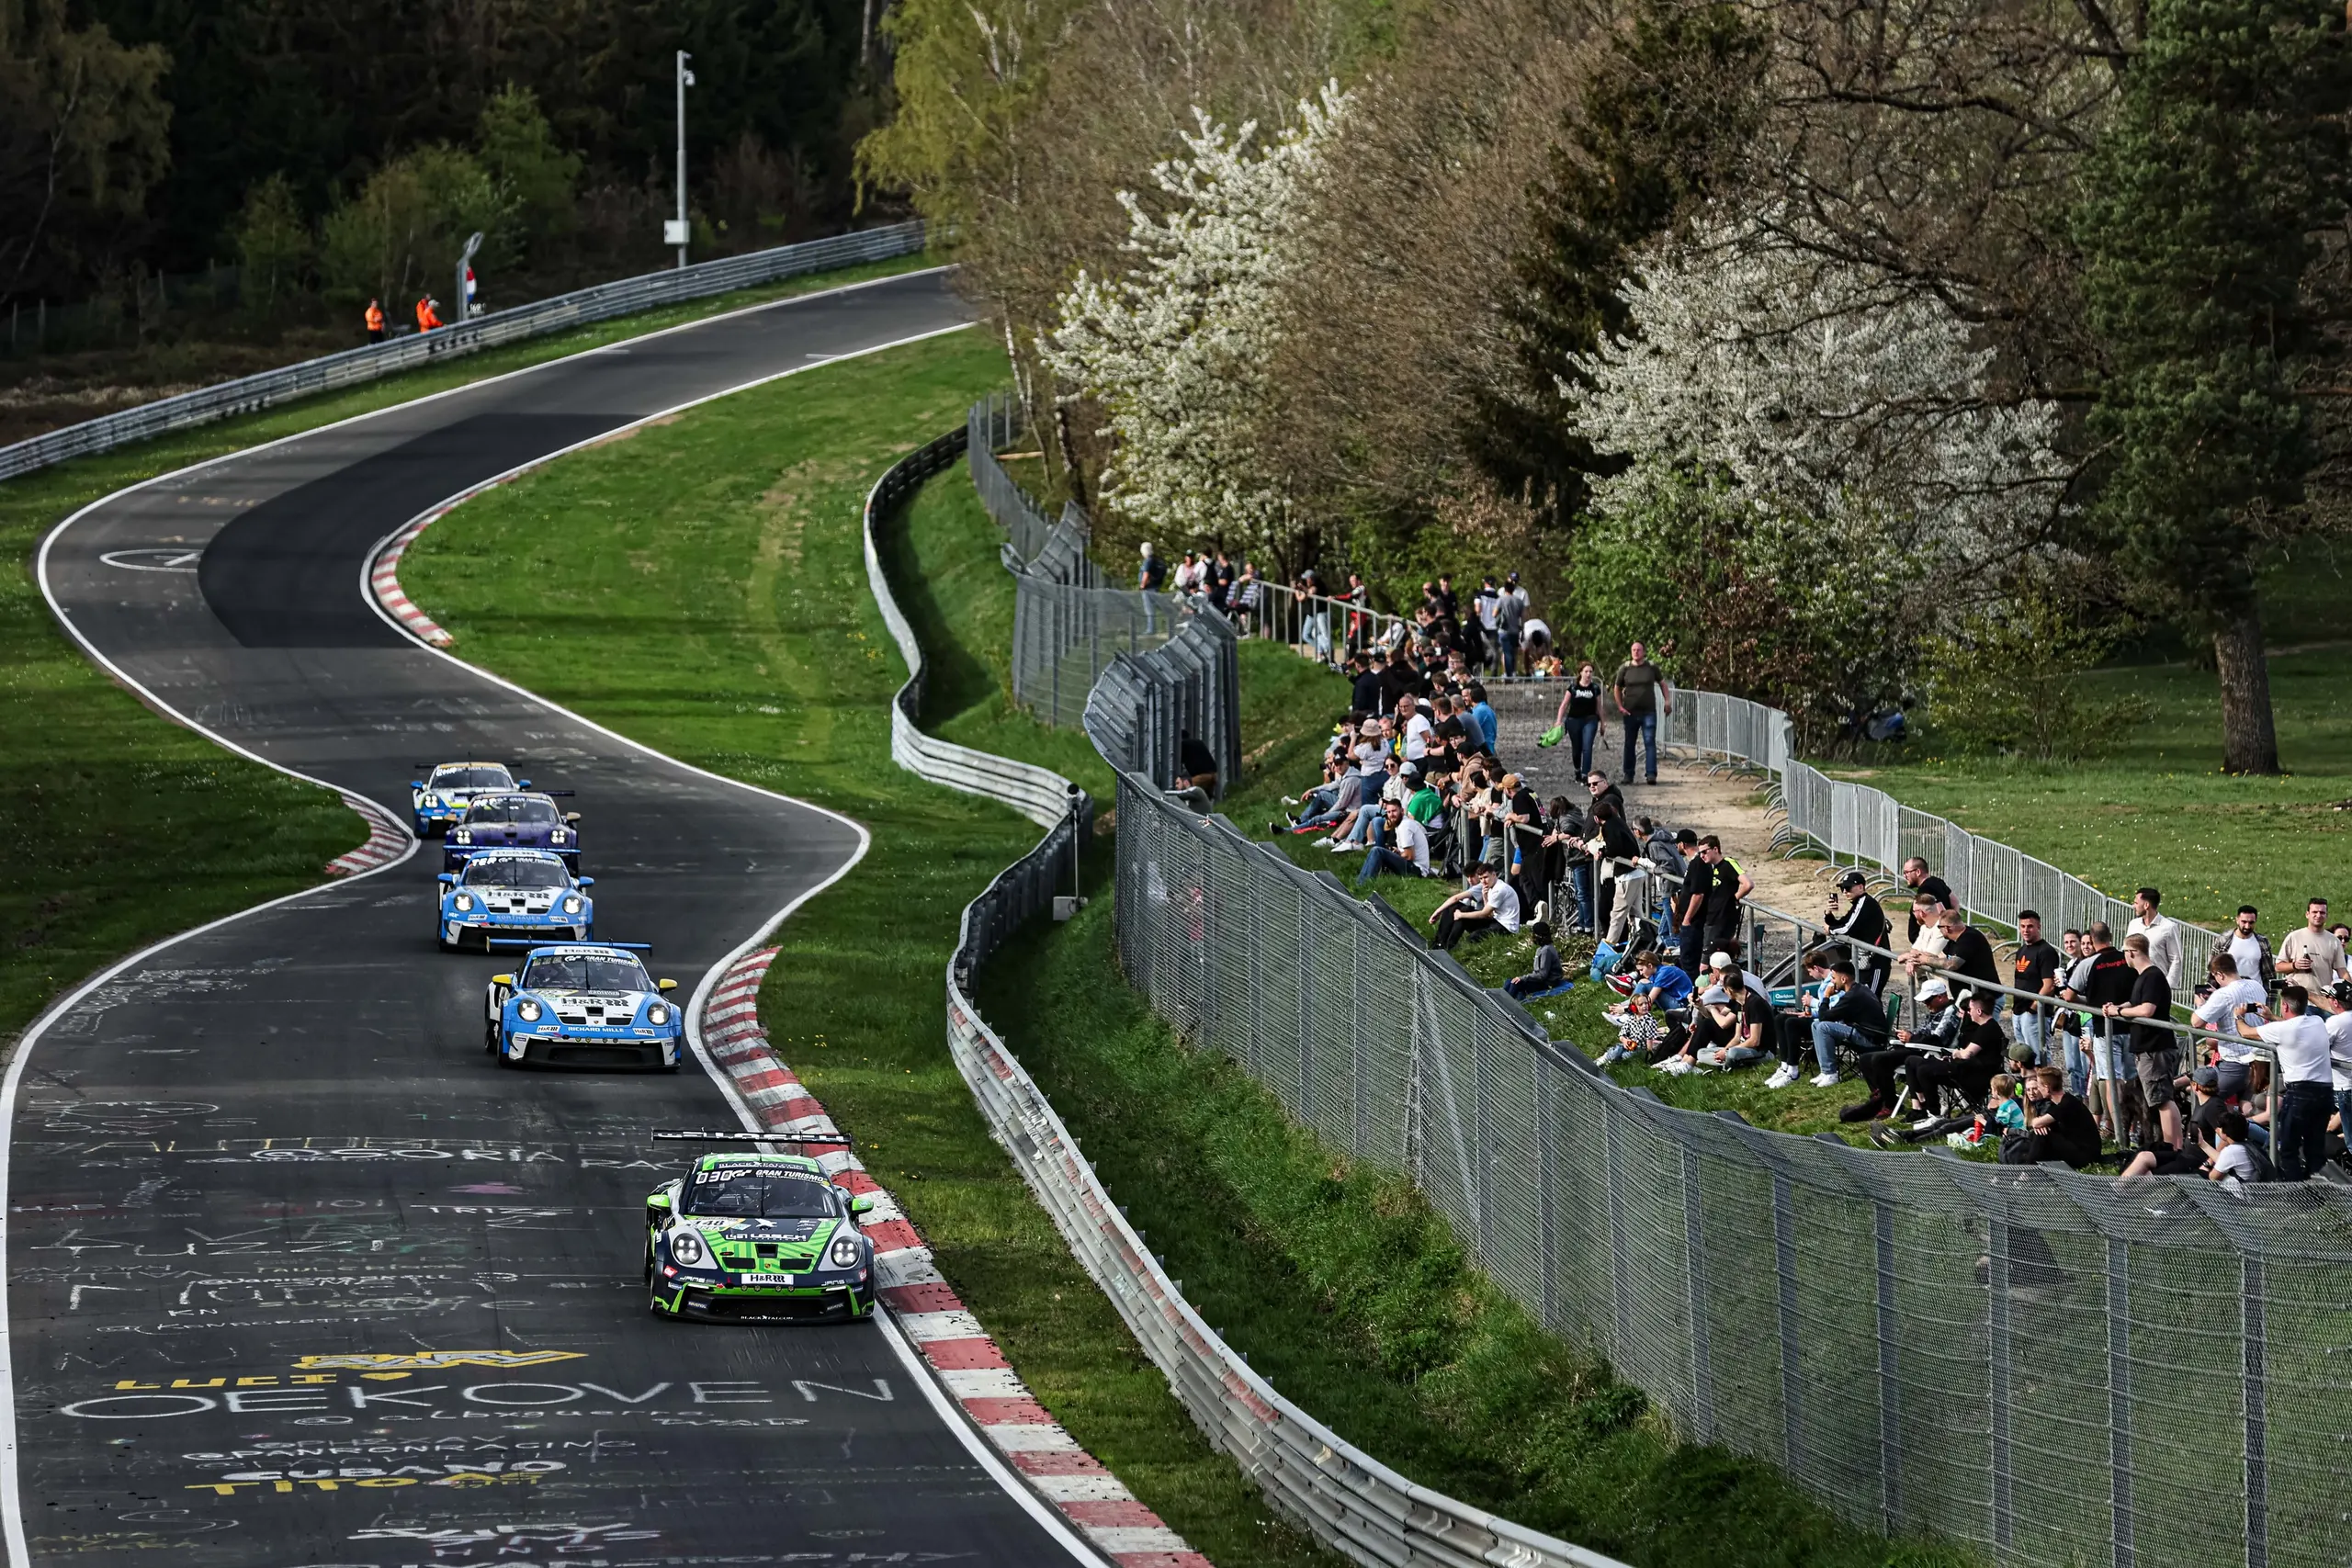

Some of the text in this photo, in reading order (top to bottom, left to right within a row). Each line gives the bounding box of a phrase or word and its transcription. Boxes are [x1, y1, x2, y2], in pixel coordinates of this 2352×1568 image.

[695, 1169, 732, 1185] 030
[784, 1169, 824, 1182] TURISMO
[114, 1373, 337, 1390] LUCI
[61, 1379, 894, 1419] OEKOVEN
